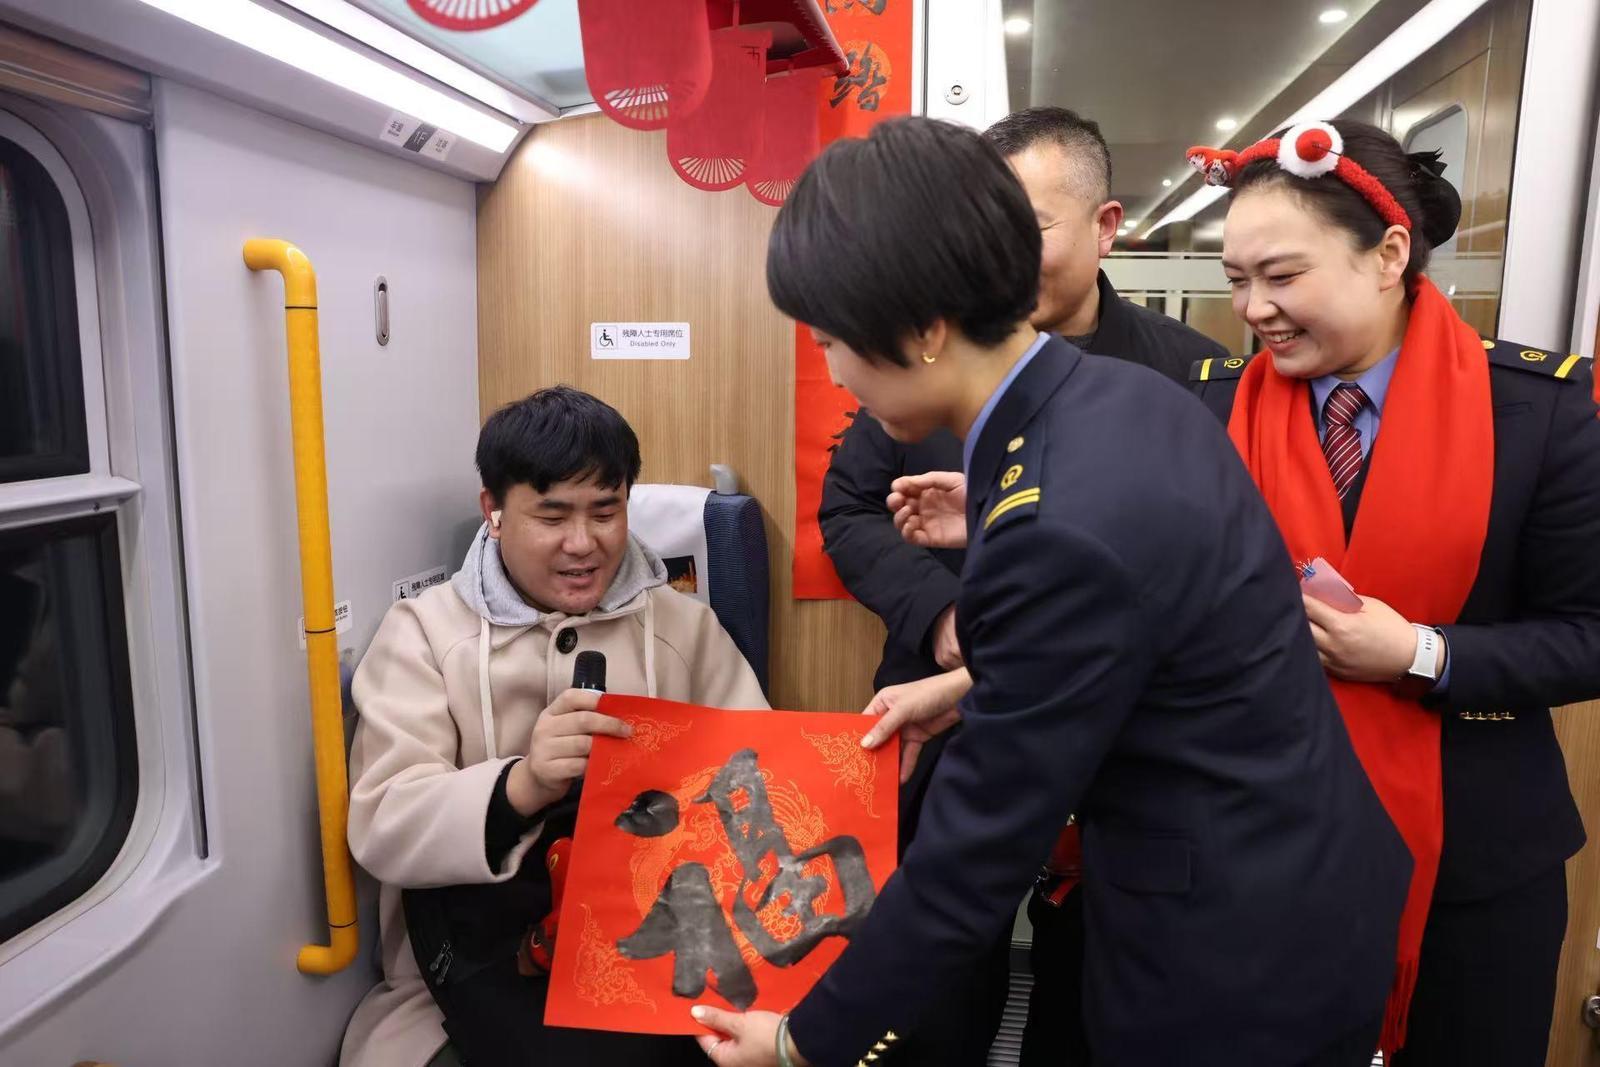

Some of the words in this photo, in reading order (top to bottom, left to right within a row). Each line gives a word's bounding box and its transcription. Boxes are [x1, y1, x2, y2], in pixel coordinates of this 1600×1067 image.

[622, 329, 684, 338] 残障人士专用席位
[615, 747, 878, 1011] 福
